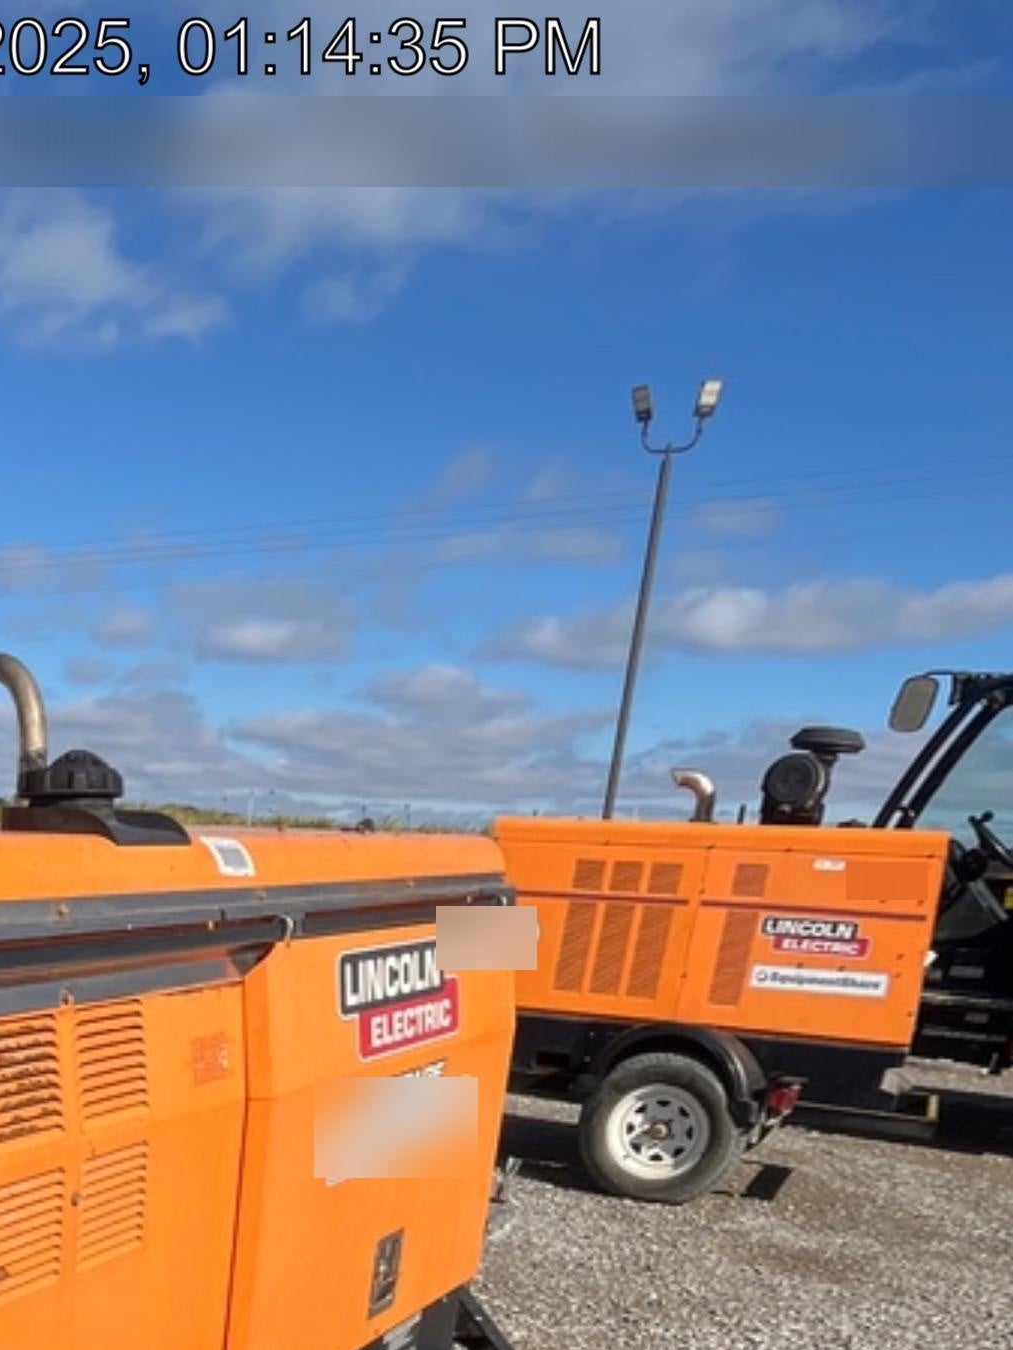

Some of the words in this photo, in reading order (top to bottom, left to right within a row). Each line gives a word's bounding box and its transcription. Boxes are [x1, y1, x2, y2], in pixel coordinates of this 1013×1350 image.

[765, 919, 854, 940] LINCOLN
[781, 938, 860, 955] ELECTRIC
[769, 971, 881, 991] EquipmentShare
[370, 999, 452, 1048] ELECTRIC
